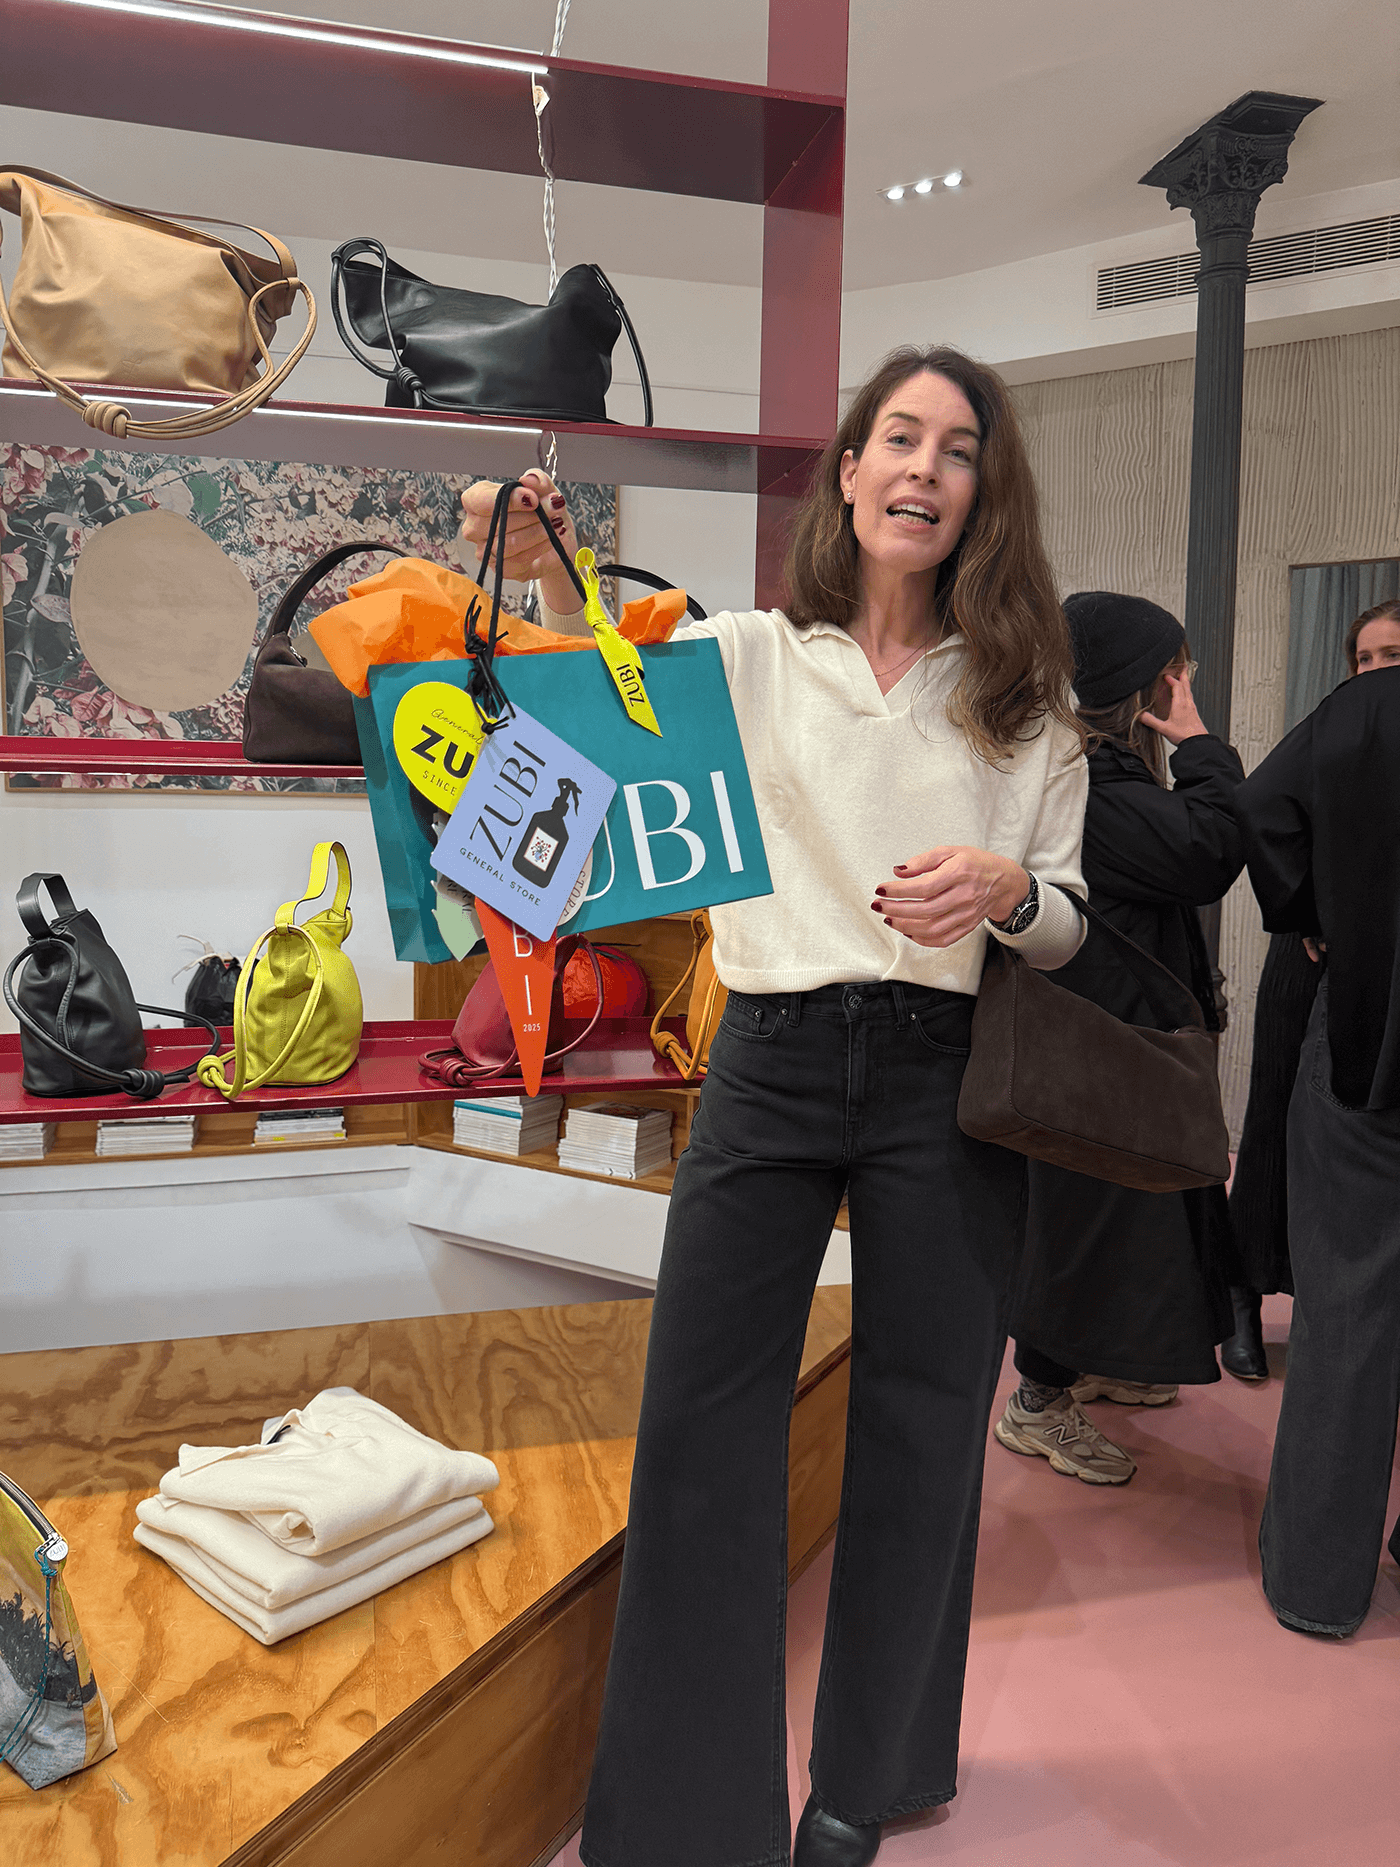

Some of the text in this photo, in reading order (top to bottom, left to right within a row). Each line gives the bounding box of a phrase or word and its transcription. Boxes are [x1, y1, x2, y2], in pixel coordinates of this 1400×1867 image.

[616, 663, 646, 707] ZUBI
[421, 770, 458, 797] SINCE
[469, 740, 547, 862] ZUBI
[459, 847, 505, 882] GENERAL
[509, 880, 542, 906] STORE
[522, 1022, 541, 1033] 2025
